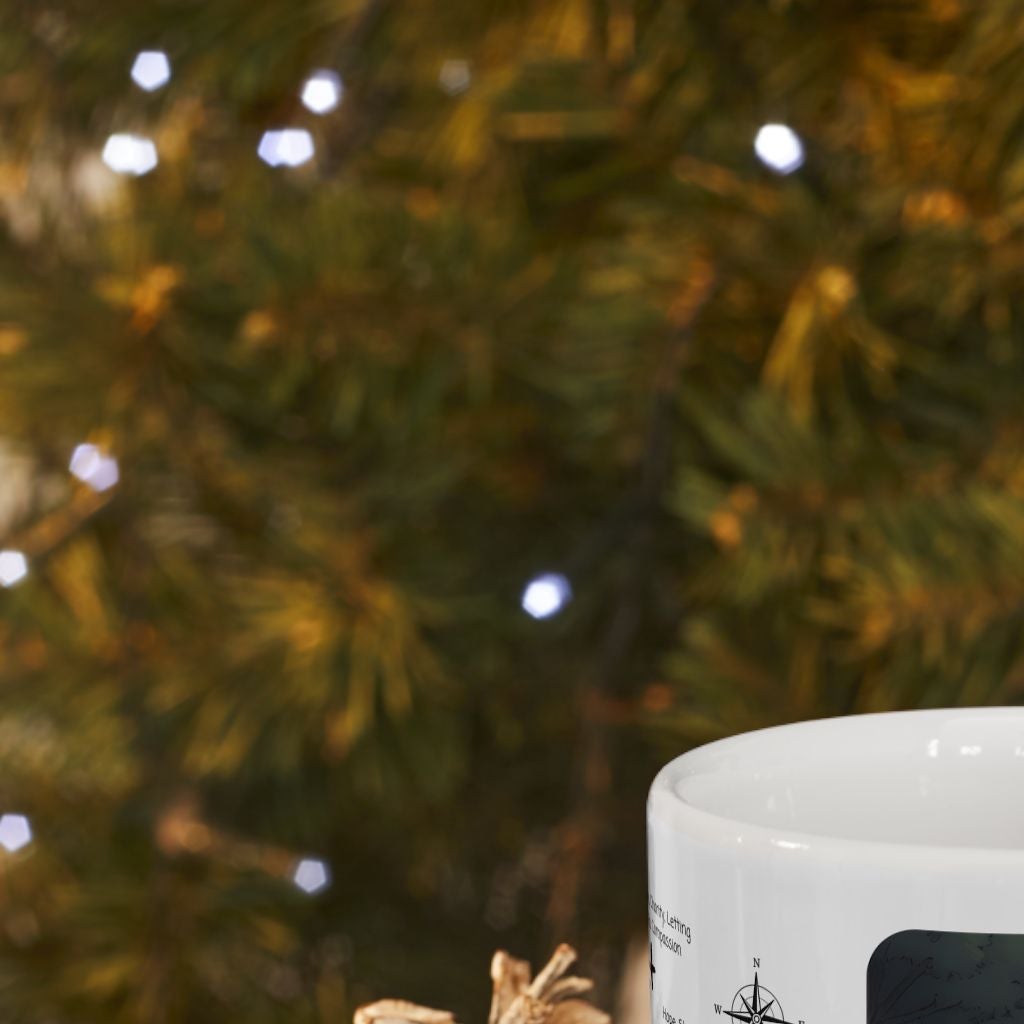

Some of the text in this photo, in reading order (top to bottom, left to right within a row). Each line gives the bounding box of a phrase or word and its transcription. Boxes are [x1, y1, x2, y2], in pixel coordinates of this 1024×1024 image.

[666, 910, 692, 944] Letting
[753, 958, 761, 968] N
[714, 1004, 723, 1015] W
